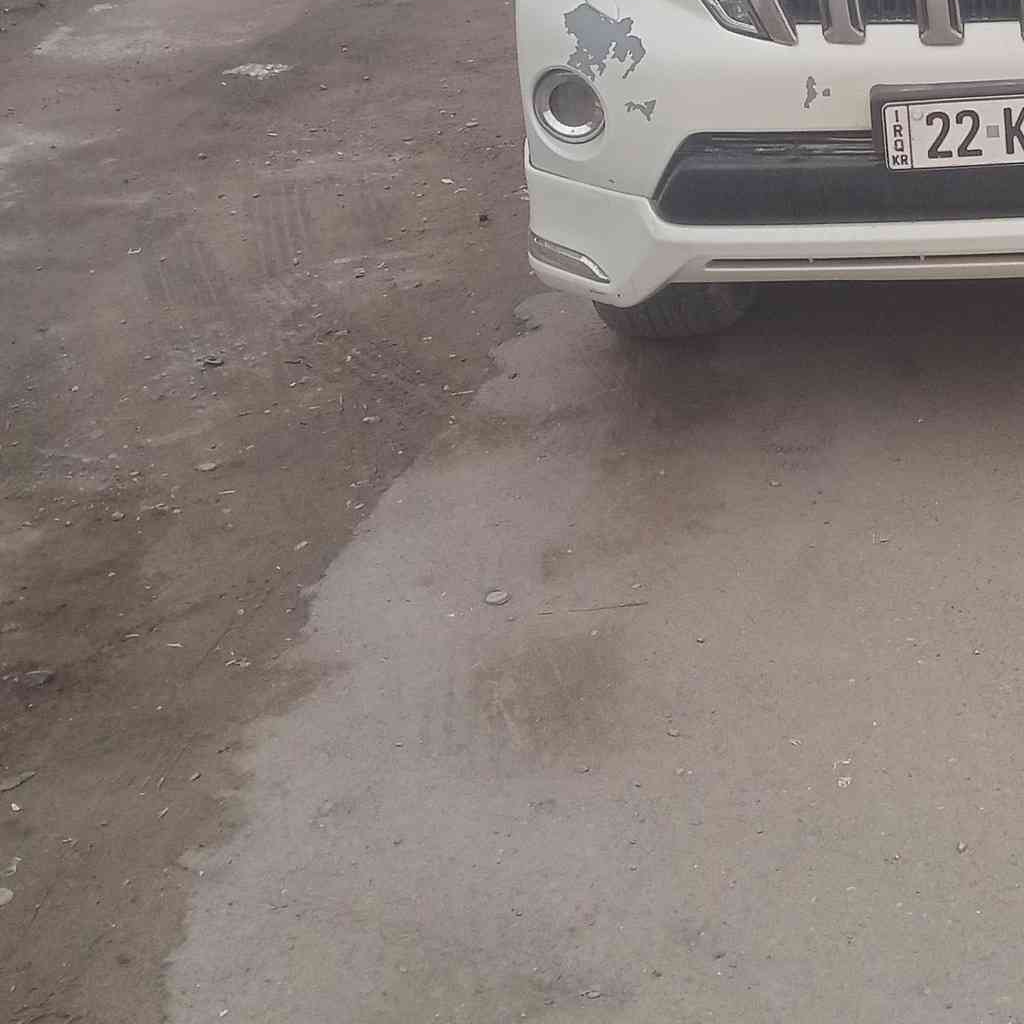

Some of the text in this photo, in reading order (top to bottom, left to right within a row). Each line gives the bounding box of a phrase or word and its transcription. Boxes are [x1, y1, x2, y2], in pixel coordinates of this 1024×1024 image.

[892, 109, 905, 152] IRQ
[926, 109, 984, 159] 22
[891, 154, 909, 166] KR
